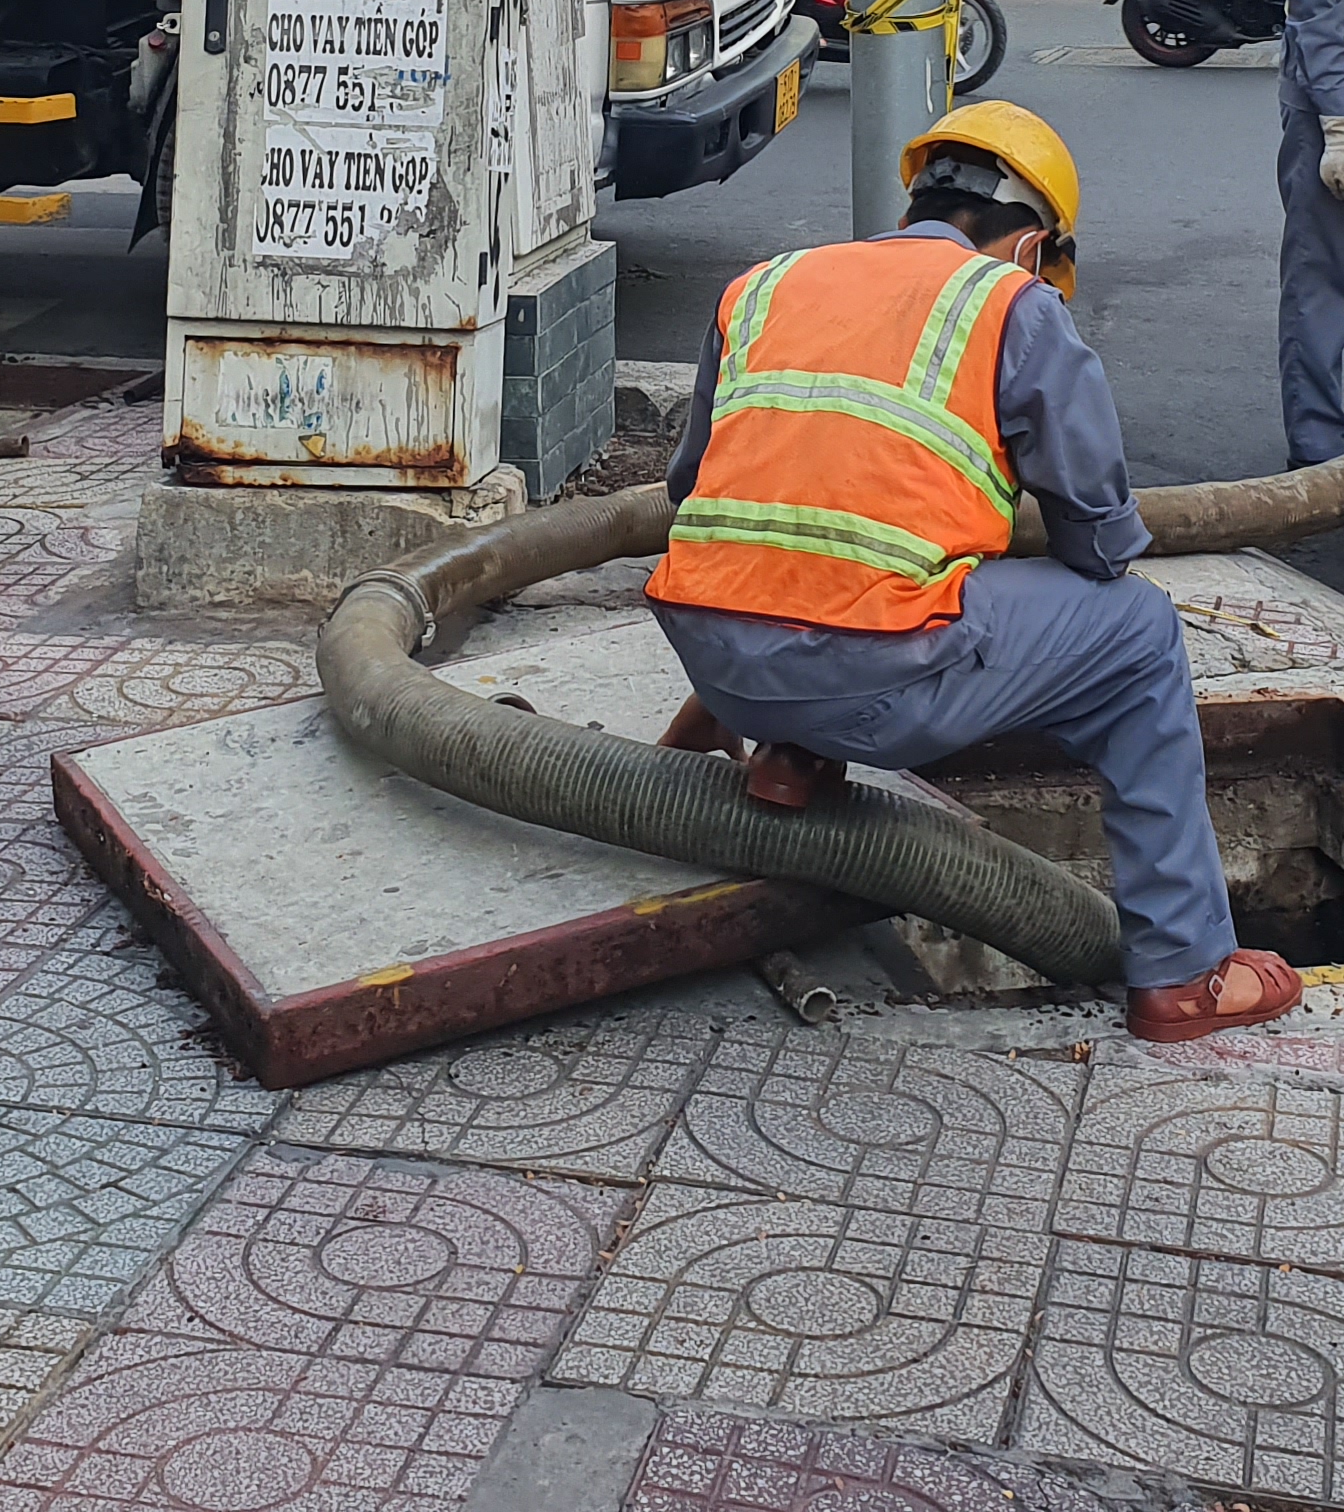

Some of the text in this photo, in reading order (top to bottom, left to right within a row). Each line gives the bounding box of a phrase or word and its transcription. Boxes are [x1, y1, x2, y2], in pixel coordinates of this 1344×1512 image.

[268, 13, 305, 53] CHO
[310, 14, 350, 55] VAY
[402, 8, 440, 59] GÓP
[267, 63, 327, 107] 0877
[300, 149, 339, 190] VAY
[324, 199, 366, 248] 551
